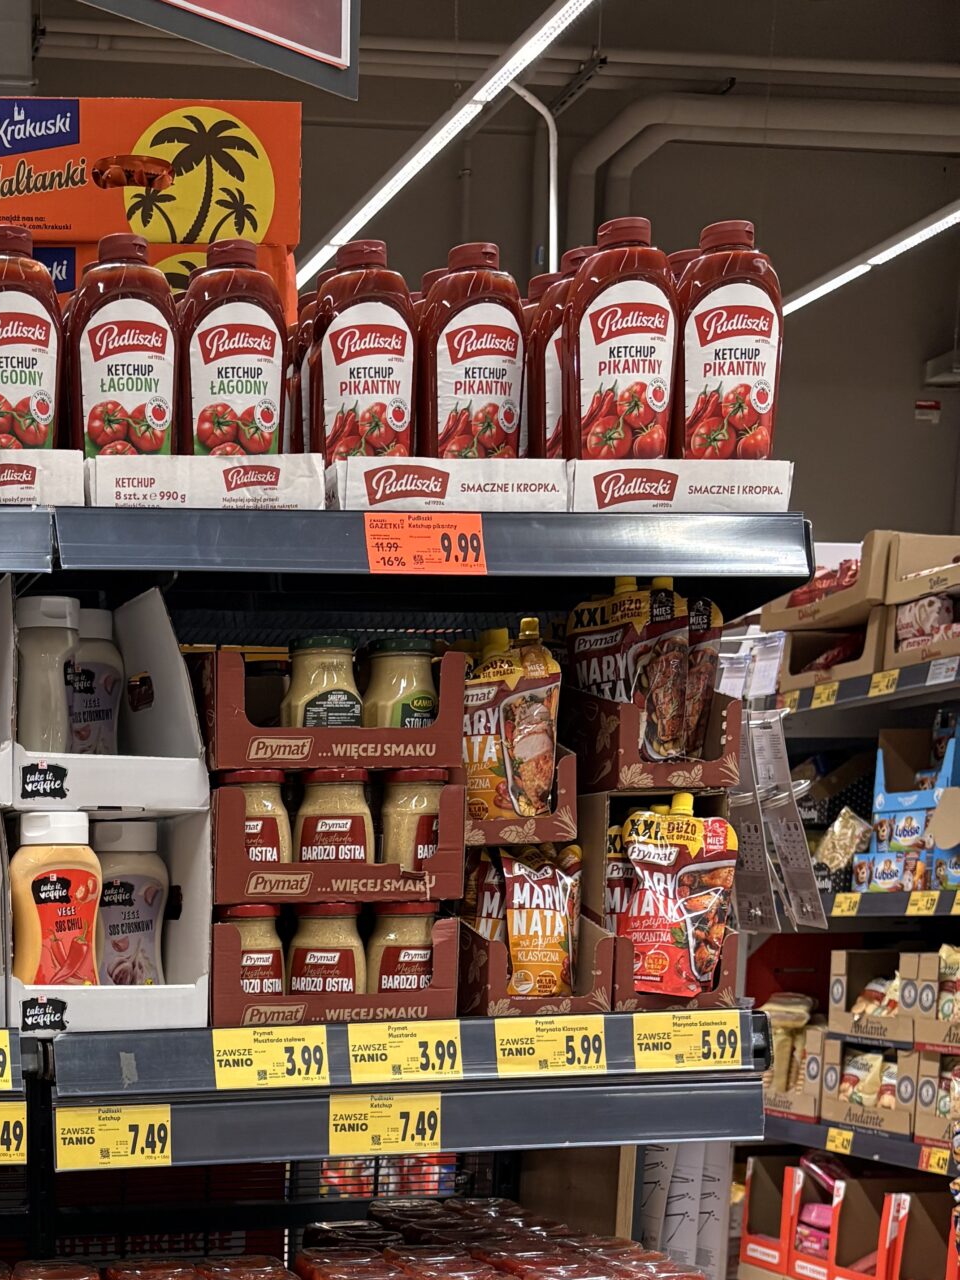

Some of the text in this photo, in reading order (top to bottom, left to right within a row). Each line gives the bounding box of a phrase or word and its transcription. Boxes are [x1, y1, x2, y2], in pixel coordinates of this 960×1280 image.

[597, 307, 665, 339] Pudliszki
[703, 310, 770, 341] Pudliszki
[95, 325, 163, 355] Pudliszki
[608, 346, 656, 360] KETCHUP
[714, 348, 760, 361] KETCHUP
[107, 363, 154, 377] KETCHUP
[349, 367, 394, 379] KETCHUP
[598, 359, 662, 376] PIKANTNY
[703, 361, 766, 378] PIKANTNY
[100, 377, 160, 393] ŁAGODNY
[339, 380, 401, 396] PIKANTNY
[600, 472, 672, 505] Pudliszki
[688, 485, 783, 495] SMACZNE I KROPKA.
[440, 532, 481, 564] 9.99
[375, 556, 406, 567] -16%
[256, 740, 306, 760] Prymat
[384, 744, 436, 756] SMAKU
[895, 823, 920, 839] Lubisie
[512, 910, 564, 936] NATA
[632, 930, 670, 943] PIKANTNA
[308, 954, 336, 964] Prymat
[517, 951, 559, 962] KLASYCZNA
[291, 977, 353, 992] BARDZO OSTRA
[851, 1018, 887, 1037] Andante
[565, 1034, 602, 1065] 5.99
[701, 1029, 738, 1059] 5.99
[217, 1058, 253, 1067] TANIO
[284, 1045, 324, 1076] 3.99
[418, 1040, 457, 1071] 3.99
[845, 1107, 884, 1127] Andante
[128, 1123, 168, 1155] 7.49
